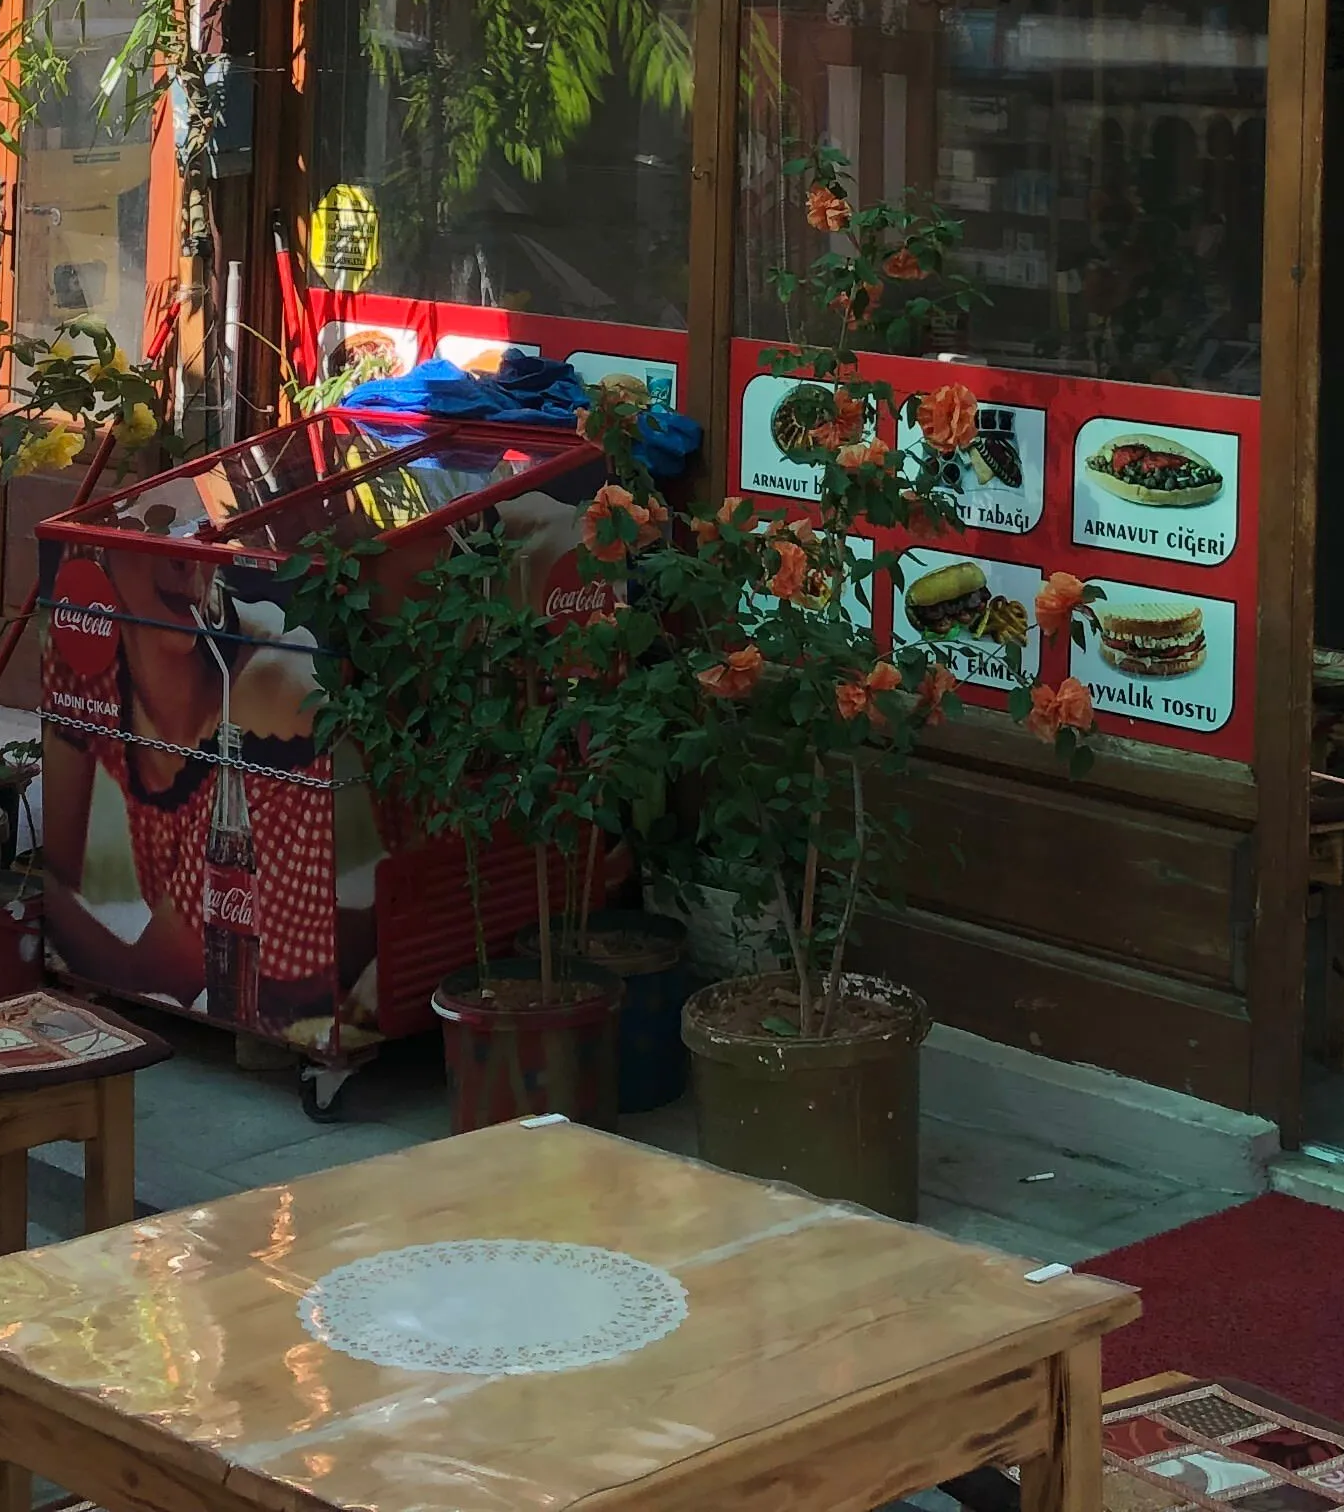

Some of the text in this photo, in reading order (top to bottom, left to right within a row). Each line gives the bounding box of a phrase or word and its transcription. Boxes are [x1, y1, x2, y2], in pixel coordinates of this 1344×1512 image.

[752, 472, 809, 493] ARNAVUT
[978, 503, 1030, 533] TABAĞI
[1083, 518, 1157, 546] ARNAVUT
[52, 691, 85, 710] TADINI
[1161, 697, 1217, 723] TOSTU
